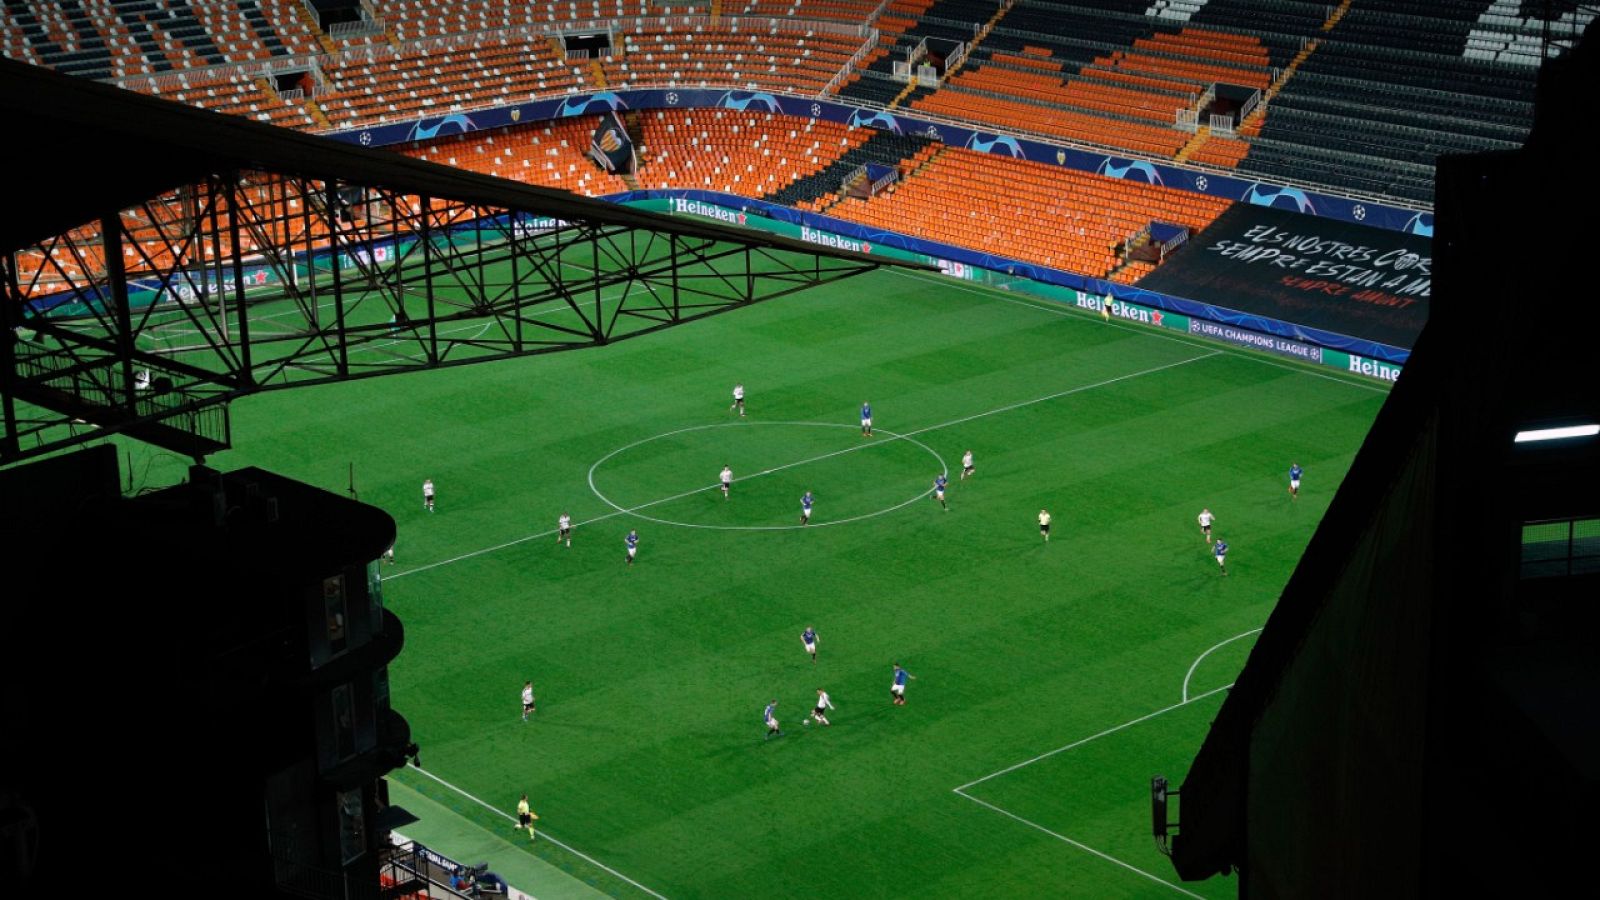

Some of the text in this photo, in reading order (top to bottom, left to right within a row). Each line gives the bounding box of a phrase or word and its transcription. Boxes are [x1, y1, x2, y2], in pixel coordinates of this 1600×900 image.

[676, 198, 736, 224] Heineken
[801, 226, 860, 252] Heineken
[1283, 235, 1377, 262] NOSTRES
[1208, 240, 1311, 268] SEMPRE
[1305, 261, 1387, 287] ESTAN
[1380, 274, 1408, 289] A
[1076, 291, 1149, 323] Heieken
[1202, 323, 1308, 356] UEFA CHAMPIONS LEAGUE
